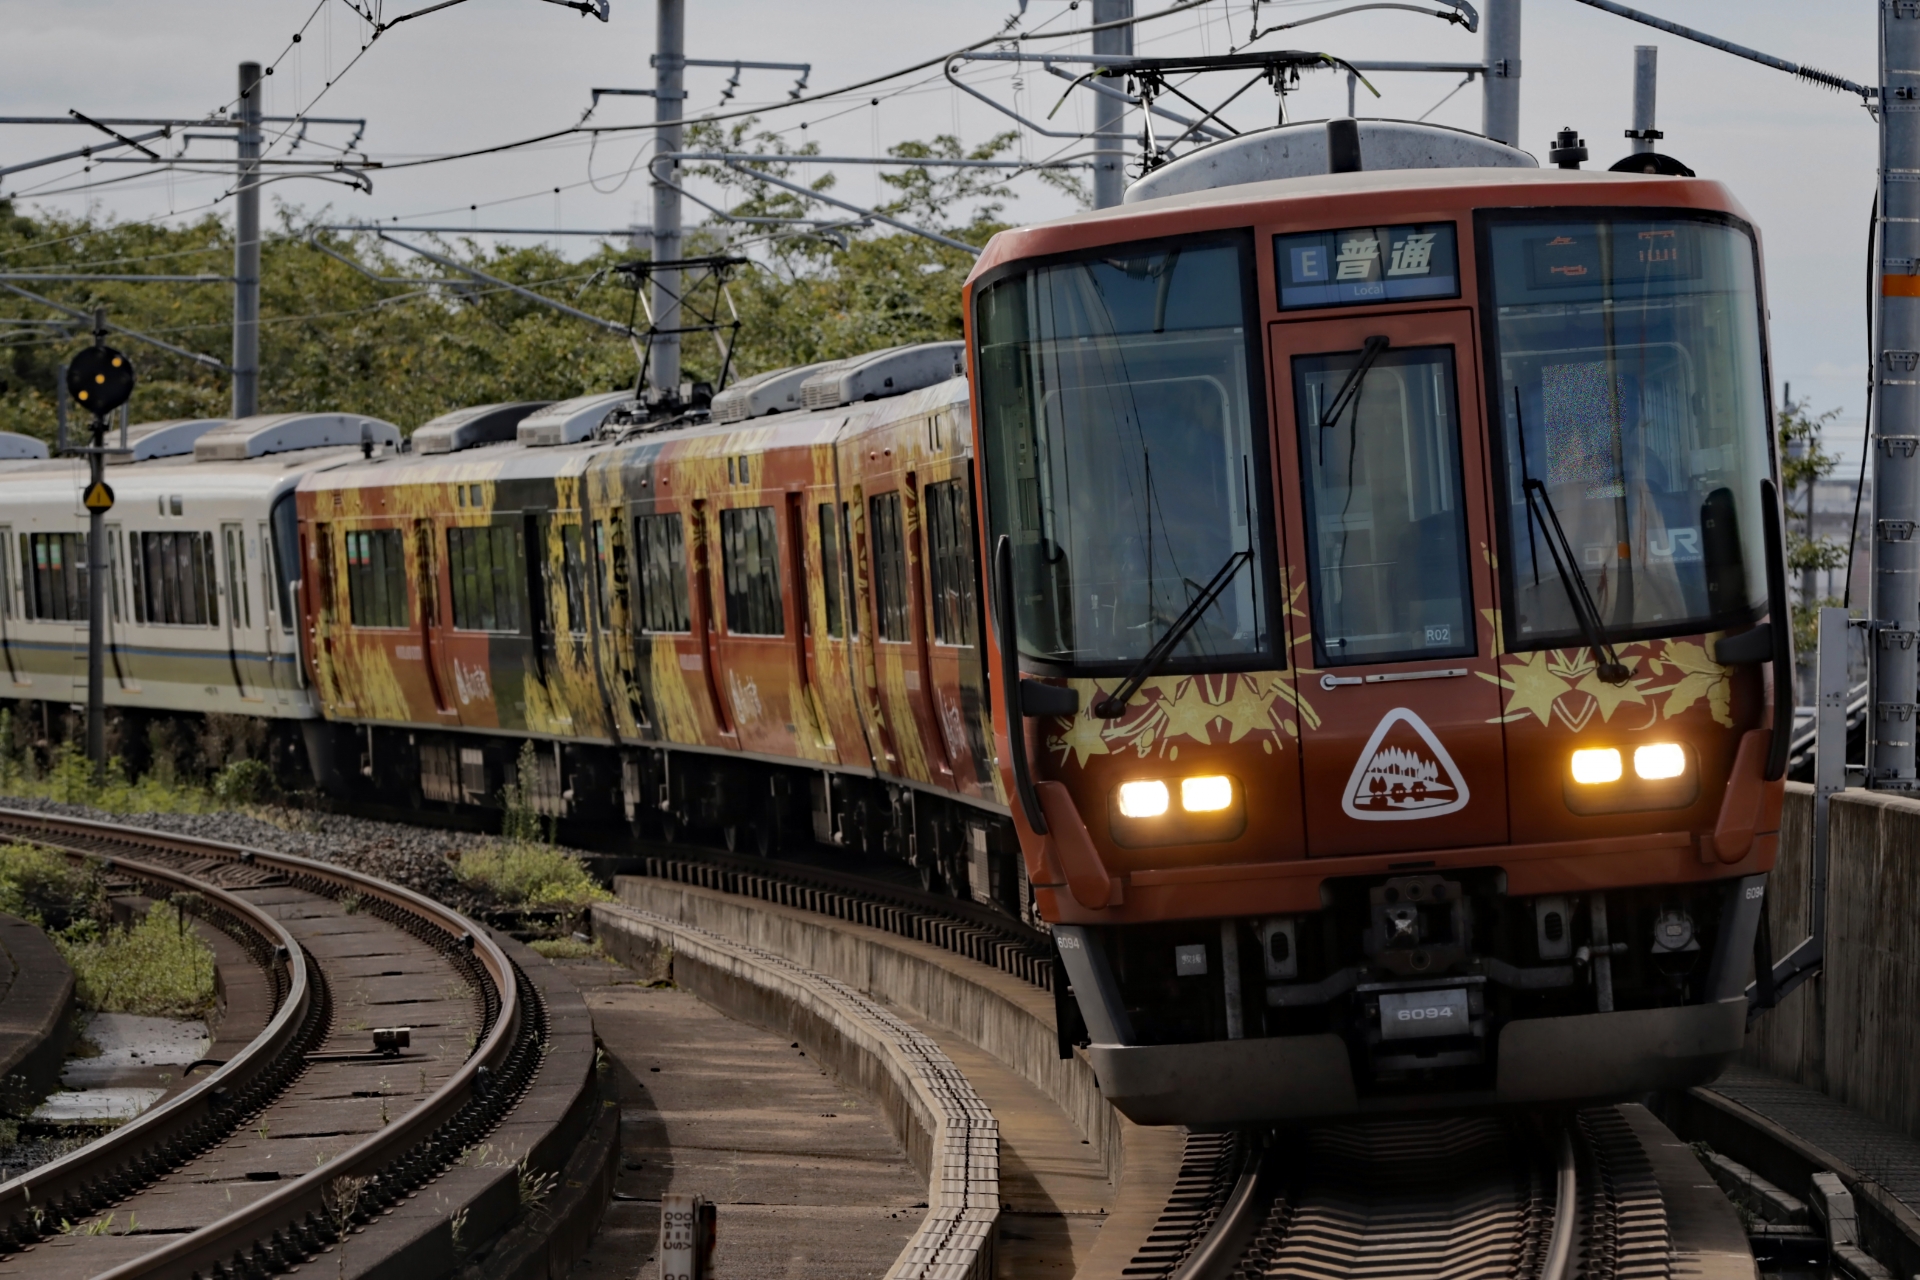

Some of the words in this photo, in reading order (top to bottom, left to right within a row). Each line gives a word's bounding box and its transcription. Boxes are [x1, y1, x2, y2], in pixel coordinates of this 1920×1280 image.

[1336, 232, 1437, 280] 普通
[1301, 251, 1318, 277] E
[1354, 283, 1384, 296] Local
[1650, 528, 1699, 556] JR
[1426, 629, 1449, 642] R02
[1746, 886, 1764, 899] 6094
[1057, 936, 1080, 949] 6094
[1397, 1006, 1453, 1021] 6094
